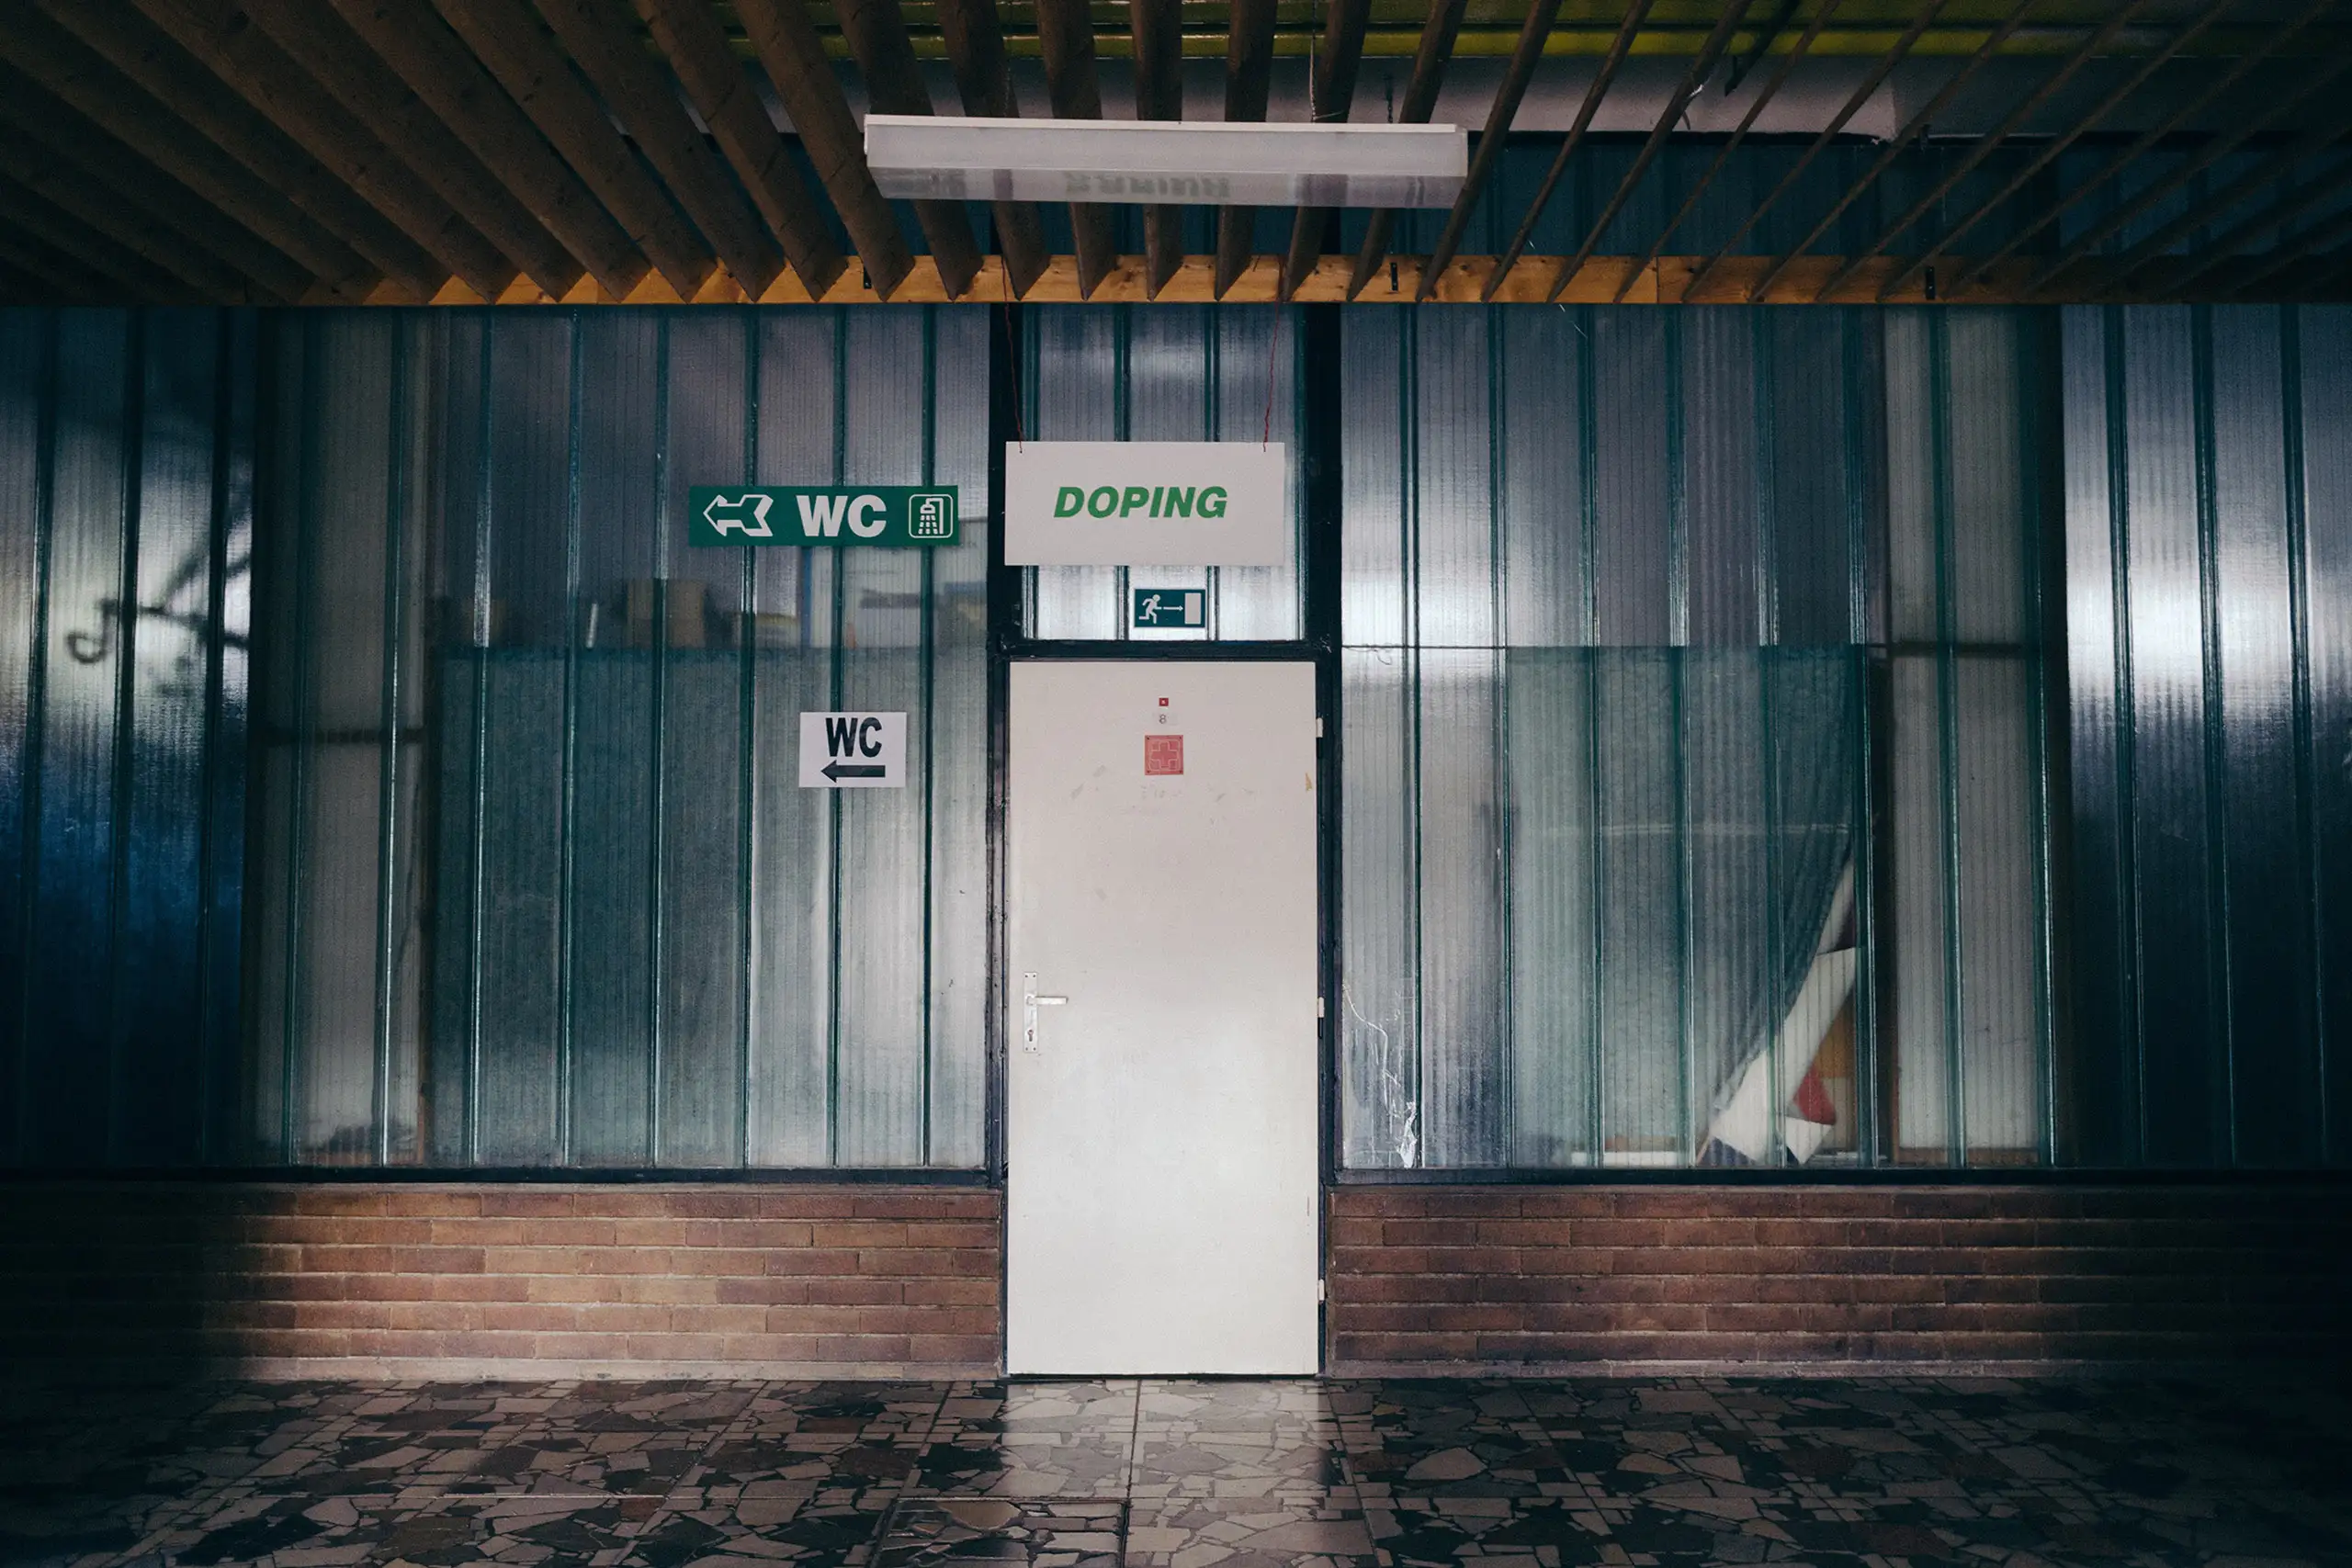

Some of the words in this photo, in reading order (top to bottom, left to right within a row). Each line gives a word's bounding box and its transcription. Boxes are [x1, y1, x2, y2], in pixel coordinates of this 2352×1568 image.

[796, 494, 887, 537] WC
[1054, 486, 1227, 519] DOPING
[826, 716, 882, 758] WC
